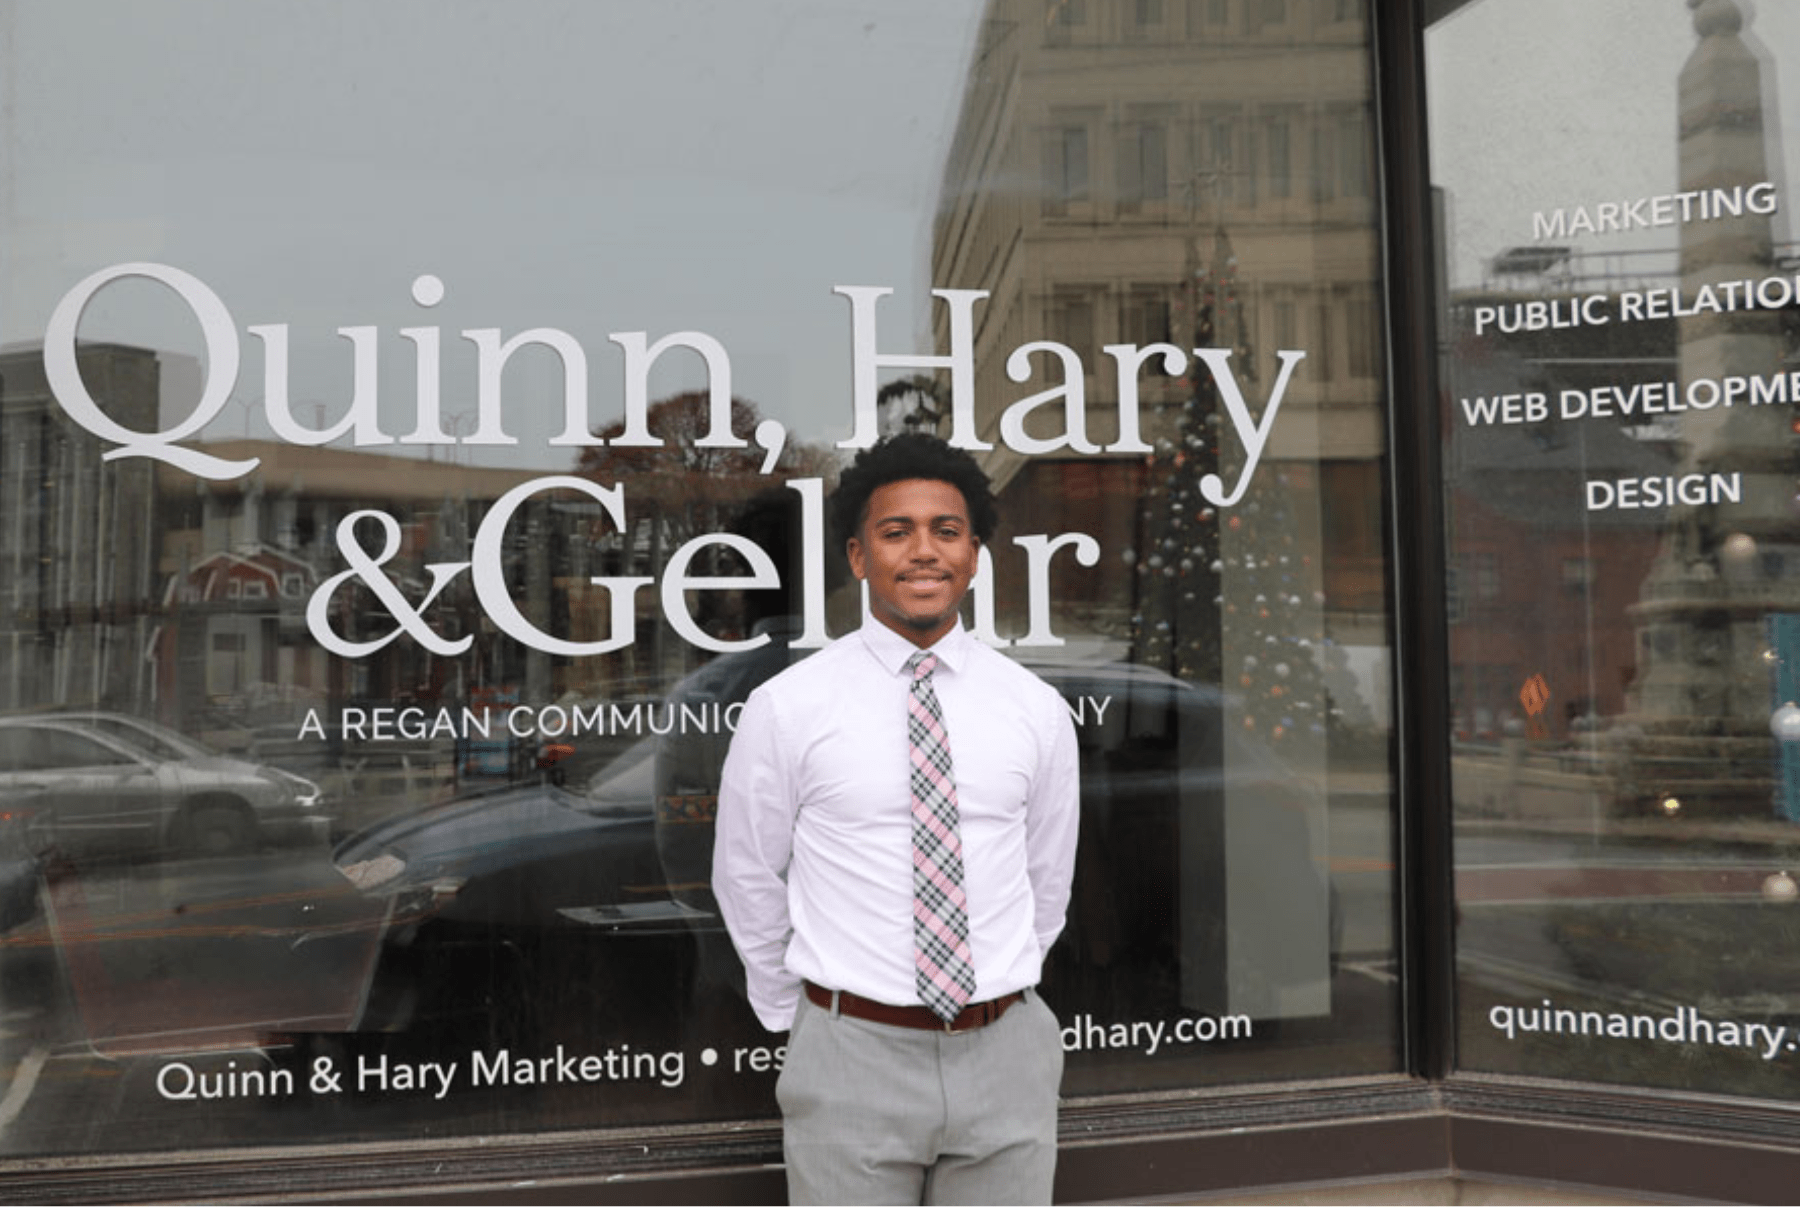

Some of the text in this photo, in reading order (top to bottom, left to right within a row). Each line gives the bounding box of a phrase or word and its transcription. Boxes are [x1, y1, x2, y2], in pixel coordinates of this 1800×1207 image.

[1532, 182, 1777, 241] MARKETING
[1474, 274, 1800, 336] PUBLIC RELATIO
[43, 262, 1306, 507] Quinn, Hary
[1461, 371, 1800, 426] WEB DEVELOPME
[1586, 472, 1742, 511] DESIGN
[297, 702, 745, 741] A REGAN COMMUNIC
[1489, 999, 1800, 1060] quinnandhary.
[155, 1062, 294, 1099] Quinn
[309, 1056, 342, 1093] &
[357, 1054, 457, 1099] Hary
[471, 1043, 685, 1087] Marketing
